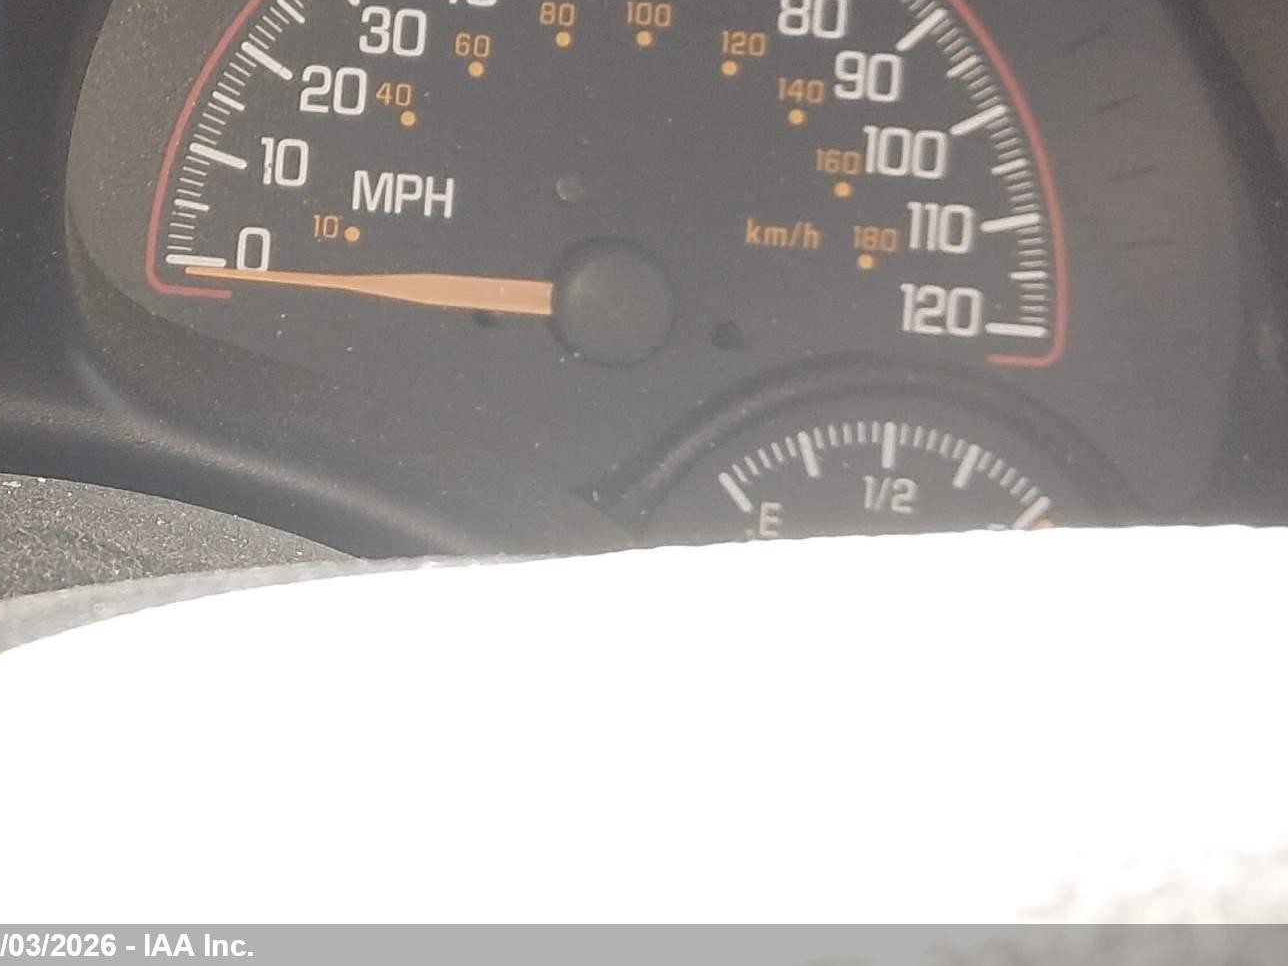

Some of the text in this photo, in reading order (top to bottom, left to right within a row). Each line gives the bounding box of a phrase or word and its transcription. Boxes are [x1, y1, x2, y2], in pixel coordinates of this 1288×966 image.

[540, 2, 574, 26] 80
[628, 2, 670, 26] 100
[359, 6, 427, 57] 30
[456, 34, 489, 57] 60
[721, 31, 766, 57] 120
[300, 66, 366, 115] 20
[779, 77, 824, 104] 140
[834, 50, 902, 101] 90
[376, 83, 411, 106] 40
[262, 138, 308, 186] 10
[816, 149, 859, 175] 160
[864, 126, 947, 179] 100
[353, 171, 453, 218] MPH
[313, 214, 339, 239] 10
[745, 219, 820, 249] km/h
[854, 225, 899, 252] 180
[907, 201, 973, 254] 110
[237, 227, 270, 270] 0
[900, 283, 981, 336] 120
[863, 476, 918, 515] 1/2
[760, 502, 782, 535] E
